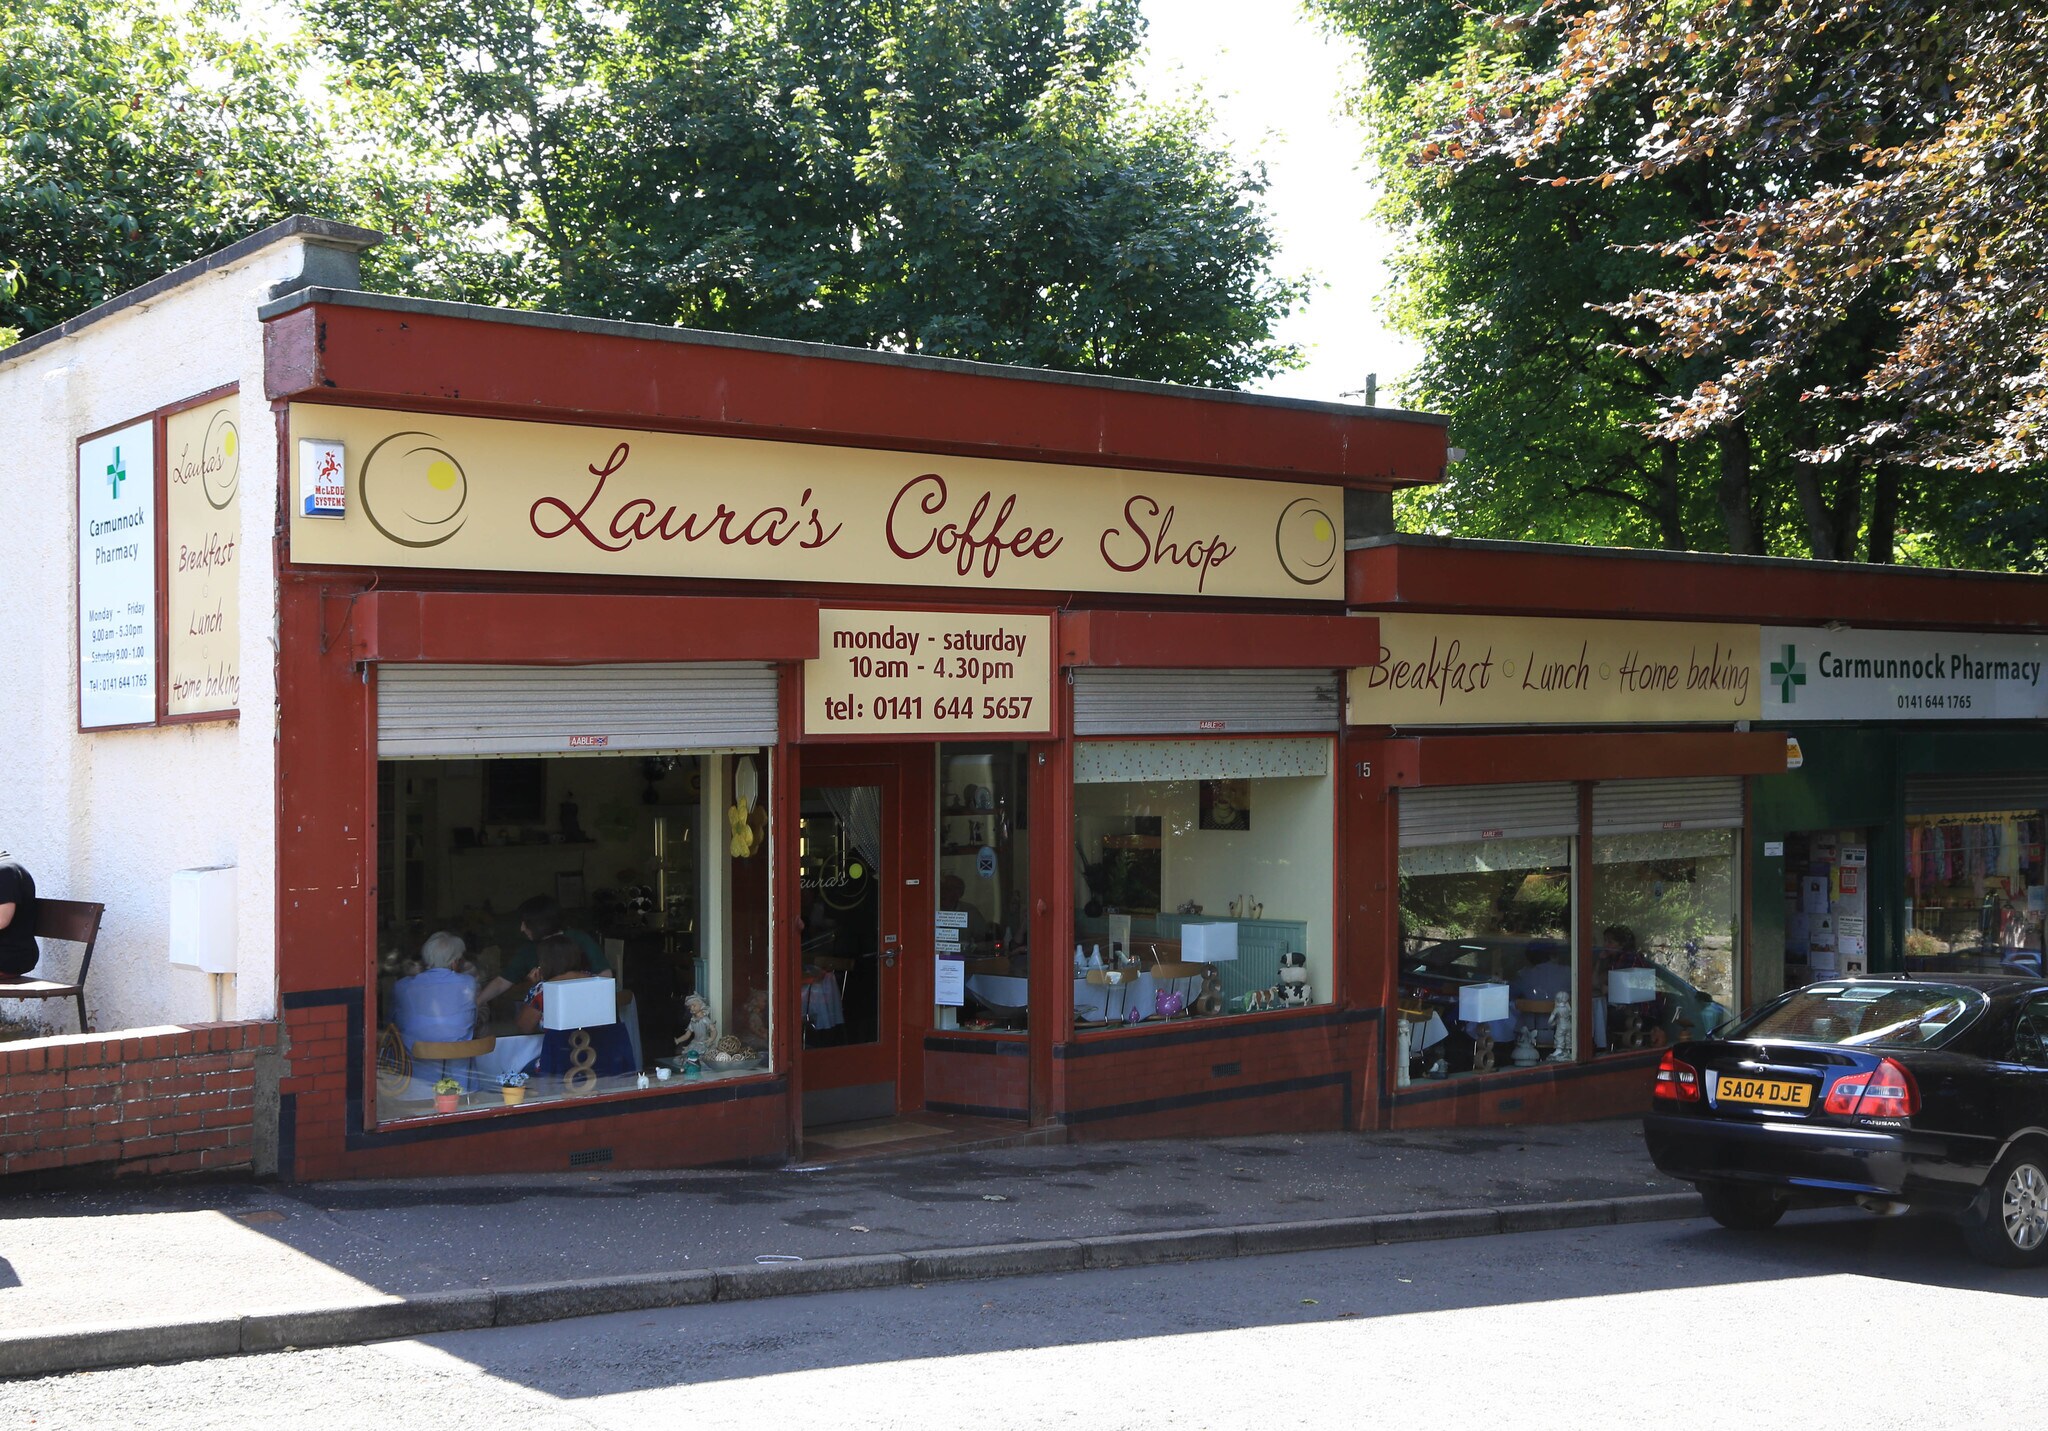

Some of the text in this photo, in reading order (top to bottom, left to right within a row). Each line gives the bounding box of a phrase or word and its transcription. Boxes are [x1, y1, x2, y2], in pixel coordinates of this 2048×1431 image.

[173, 443, 224, 484] Laura's
[315, 496, 345, 507] SYSTEMS
[90, 506, 144, 537] Carmunnock
[530, 442, 1237, 593] Laura's Coffee Shop
[95, 543, 139, 565] Pharmacy
[179, 531, 235, 577] Breakfast
[89, 607, 113, 622] Monday
[127, 602, 145, 615] Friday
[189, 596, 222, 635] Lunch
[91, 649, 115, 663] Saturday
[833, 625, 920, 655] monday
[943, 628, 1027, 657] saturday
[1368, 636, 1493, 706] Breakfast
[1522, 640, 1588, 691] Lunch
[1619, 642, 1750, 706] Home baking
[1818, 651, 2041, 686] Carmunnock Pharmacy
[102, 678, 117, 690] 0141
[119, 676, 130, 689] 644
[132, 674, 147, 687] 1765
[173, 660, 240, 706] Home baking
[825, 694, 1033, 720] tel: 0141 644 5657
[1897, 695, 1971, 709] 0141 644 1765
[571, 736, 594, 746] AABLE
[1355, 762, 1371, 778] 15
[1722, 1080, 1803, 1102] SA04 DJE
